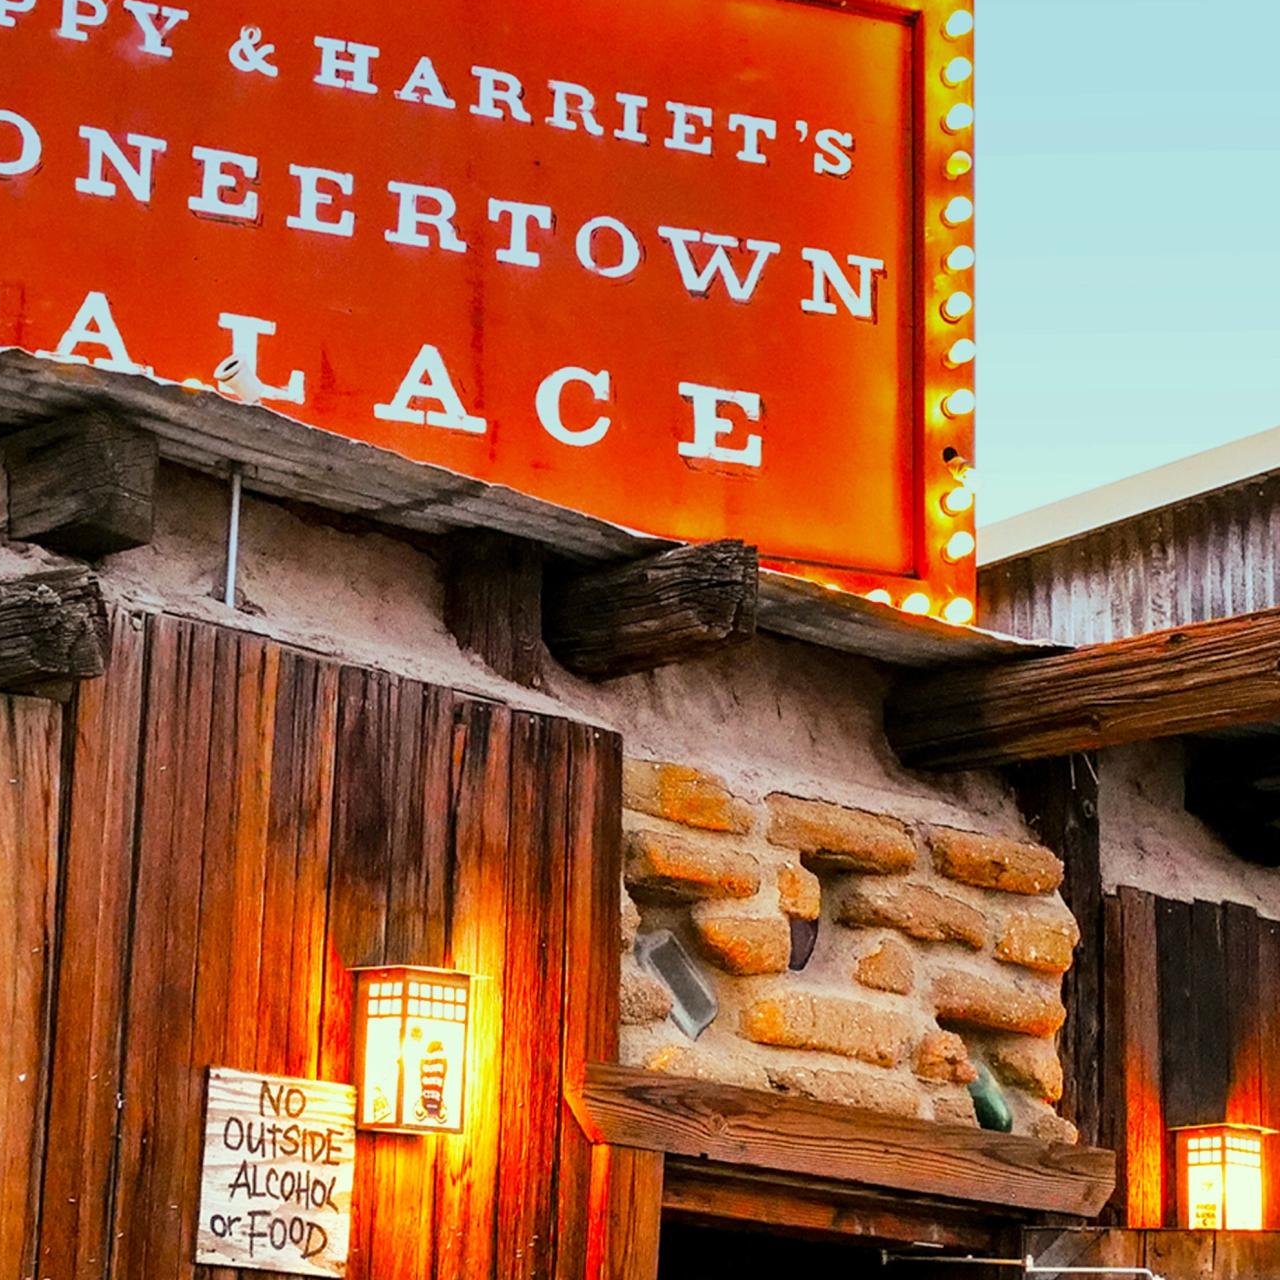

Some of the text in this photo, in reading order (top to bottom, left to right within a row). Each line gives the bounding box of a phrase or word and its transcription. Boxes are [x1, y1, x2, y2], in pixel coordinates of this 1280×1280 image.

[228, 26, 279, 78] &
[313, 36, 856, 176] HARRIET'S
[259, 1080, 306, 1118] NO
[228, 1160, 340, 1214] ALCOHOL
[247, 1210, 328, 1259] FOOD
